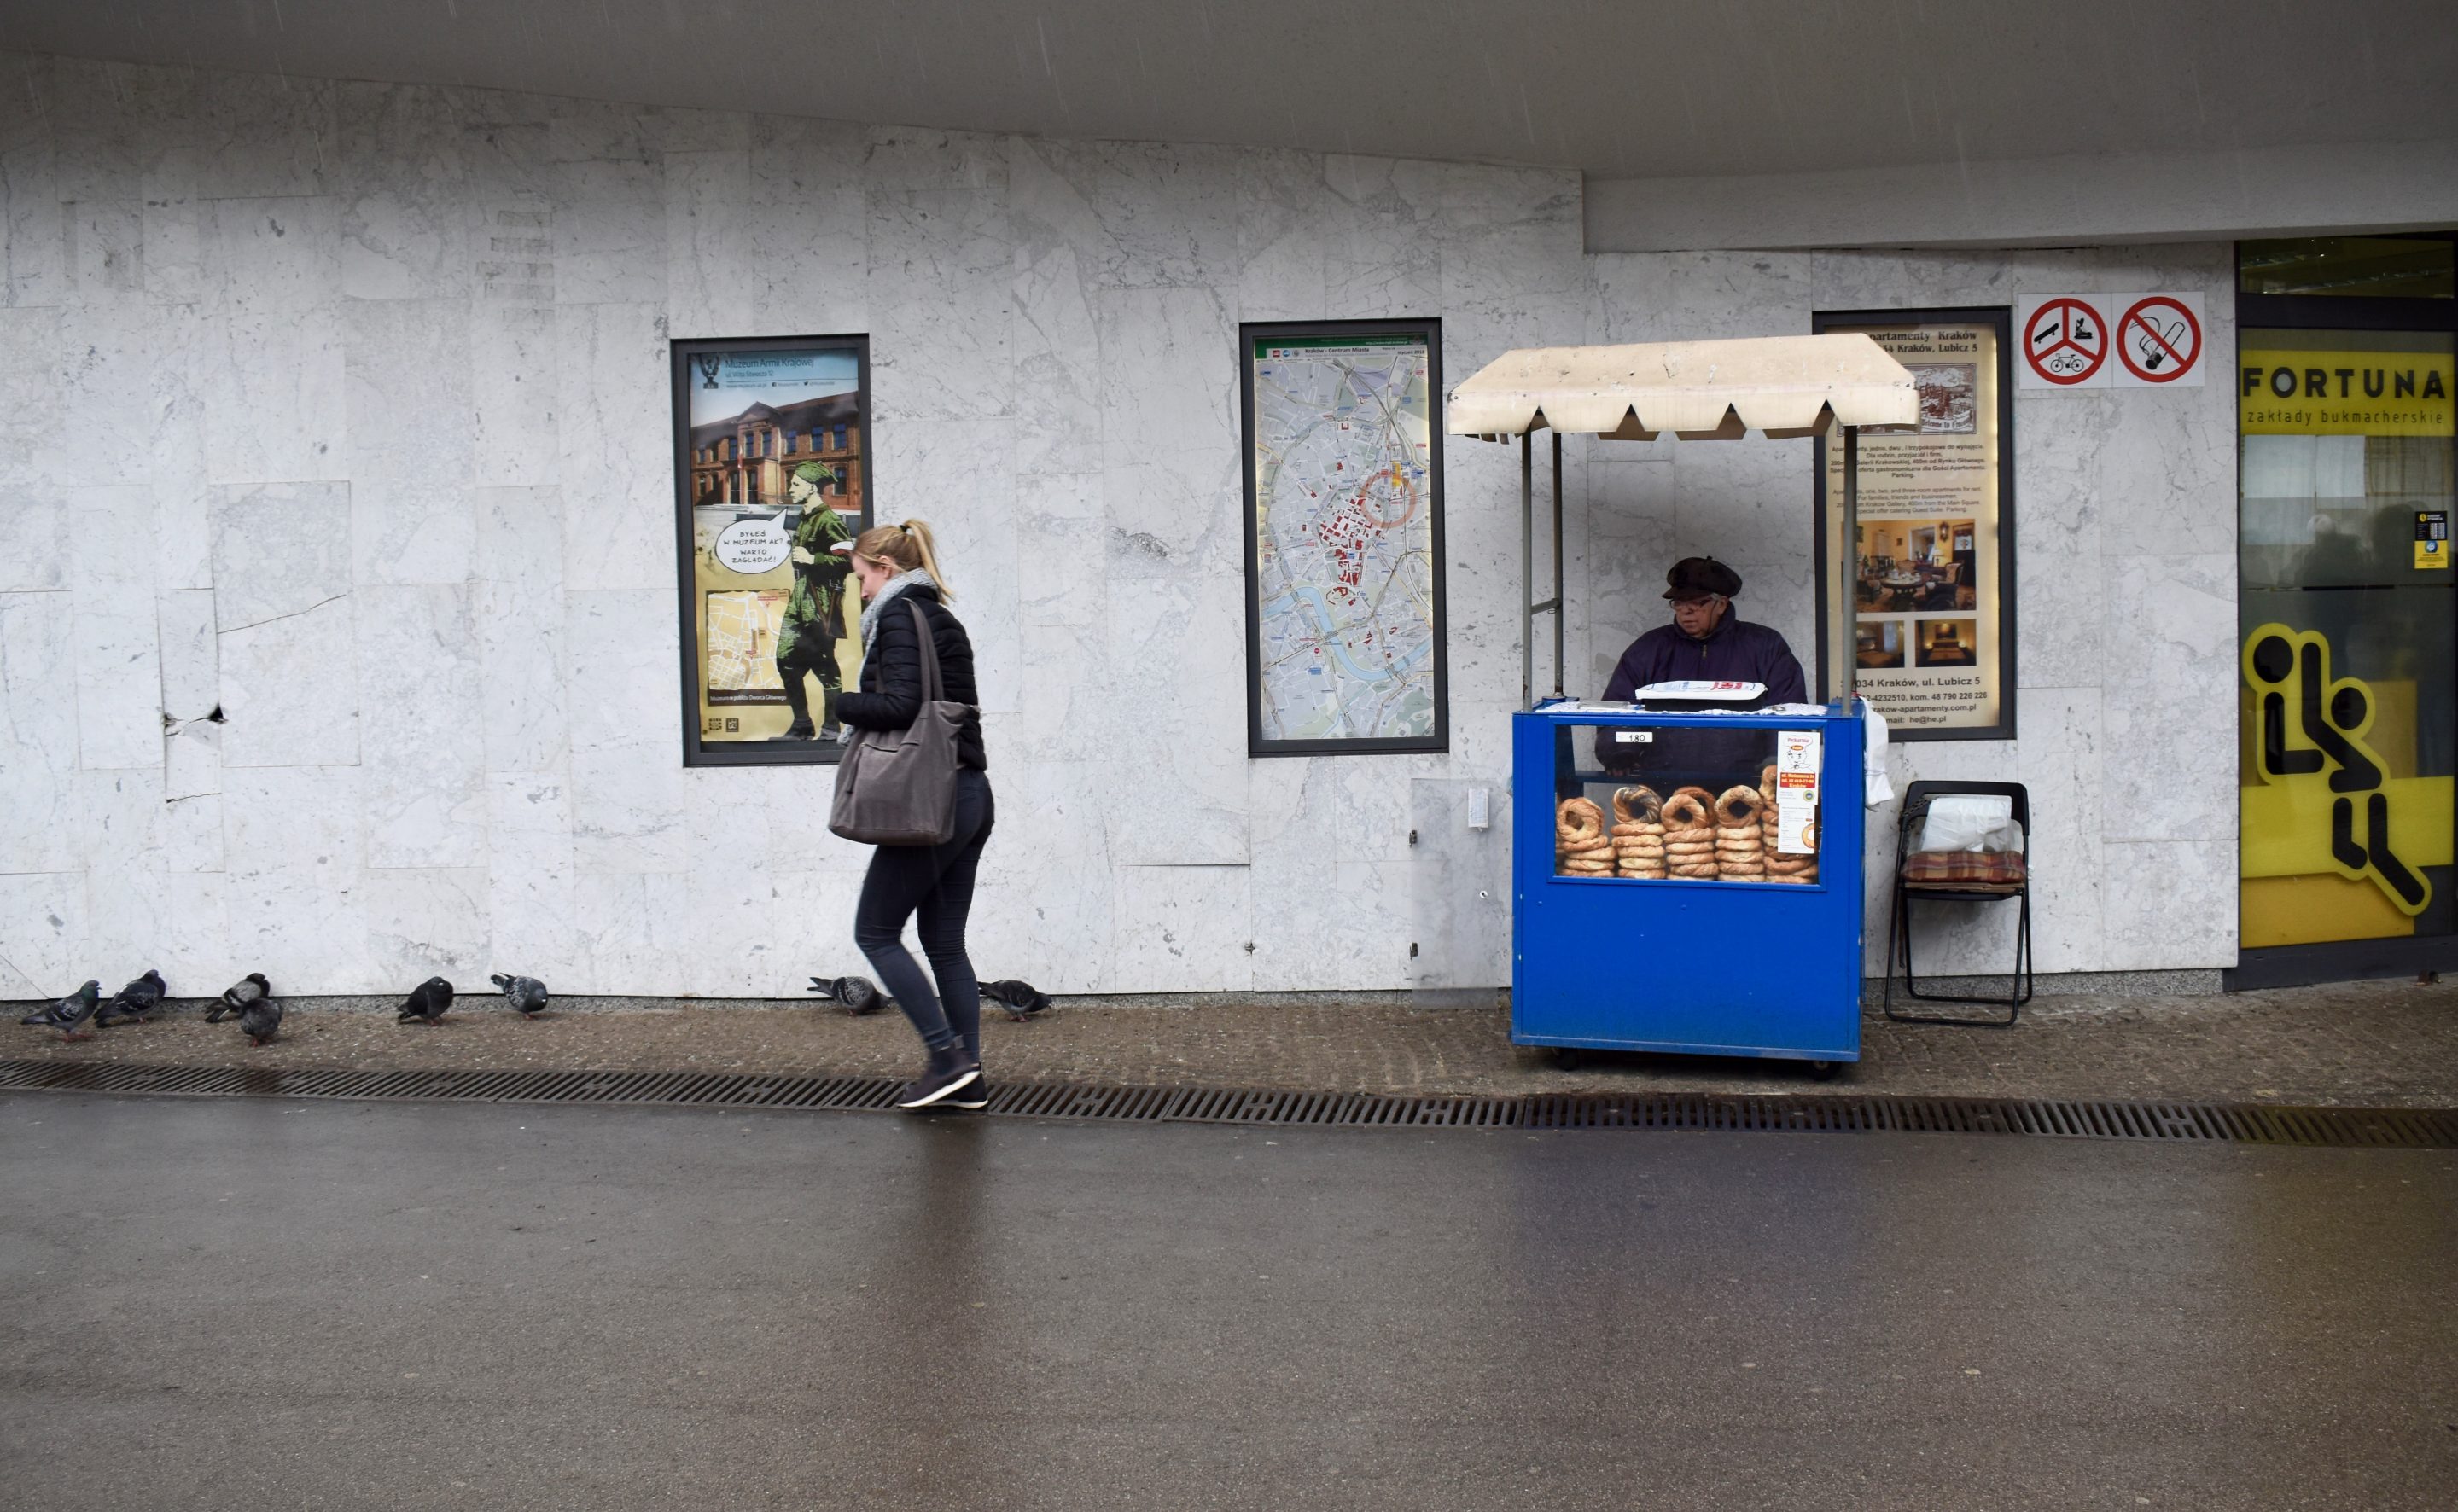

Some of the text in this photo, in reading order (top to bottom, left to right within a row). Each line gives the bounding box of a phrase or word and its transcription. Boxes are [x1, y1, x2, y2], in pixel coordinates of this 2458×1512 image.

[1867, 330, 1977, 342] partamenty Kraków
[1897, 343, 1935, 352] Kraków,
[1938, 343, 1969, 352] Lubicz
[1972, 343, 1977, 352] 5
[725, 360, 759, 369] Muzeum
[782, 358, 814, 369] Krajowej
[2243, 367, 2446, 399] FORTUNA
[2247, 409, 2443, 426] zakłady bukmacherskie
[1878, 678, 1919, 688] Kraków,
[1922, 677, 1934, 686] ul.
[1937, 677, 1972, 686] Lubicz
[1975, 677, 1980, 685] 5
[1866, 694, 1908, 702] 2-4232510,
[1873, 703, 1977, 713] rakow-apartamenty.com.pl
[1909, 715, 1947, 724] he@he.pl
